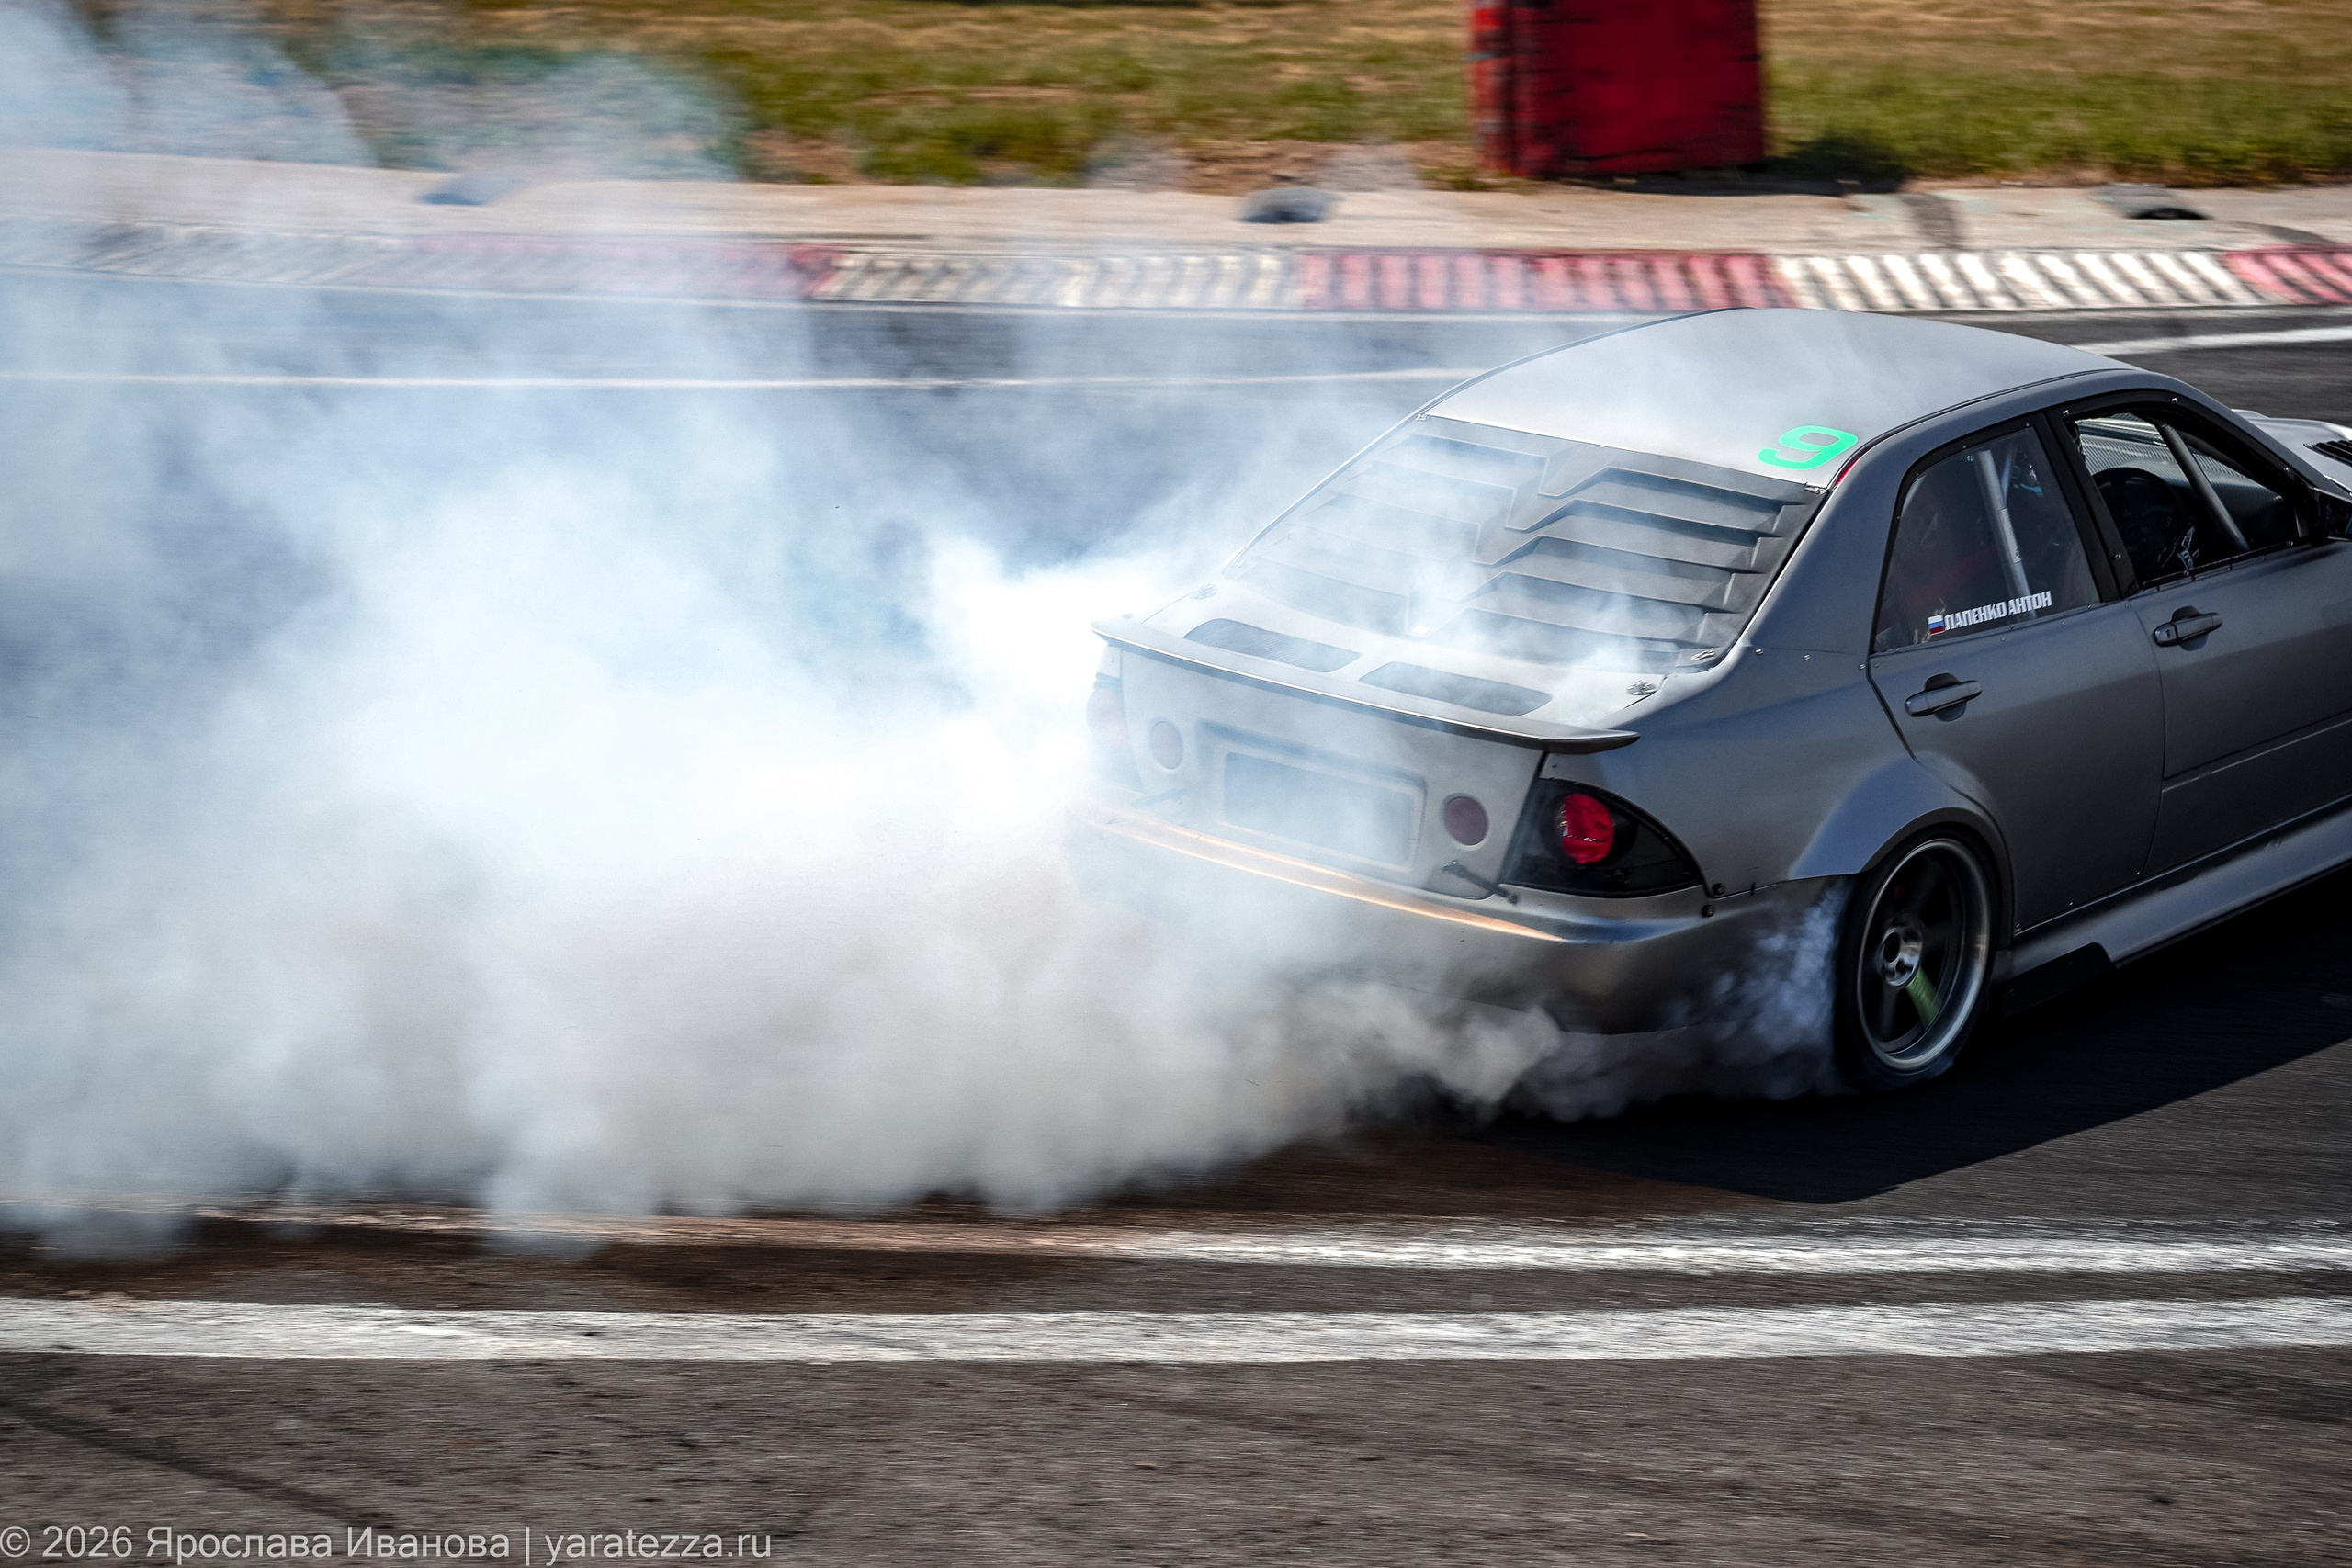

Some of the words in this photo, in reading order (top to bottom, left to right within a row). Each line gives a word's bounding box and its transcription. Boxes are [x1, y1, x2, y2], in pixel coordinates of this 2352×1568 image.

[1757, 425, 1859, 470] 9
[1943, 601, 2007, 631] ЛАПЕНКО
[2007, 590, 2052, 615] АНТОН
